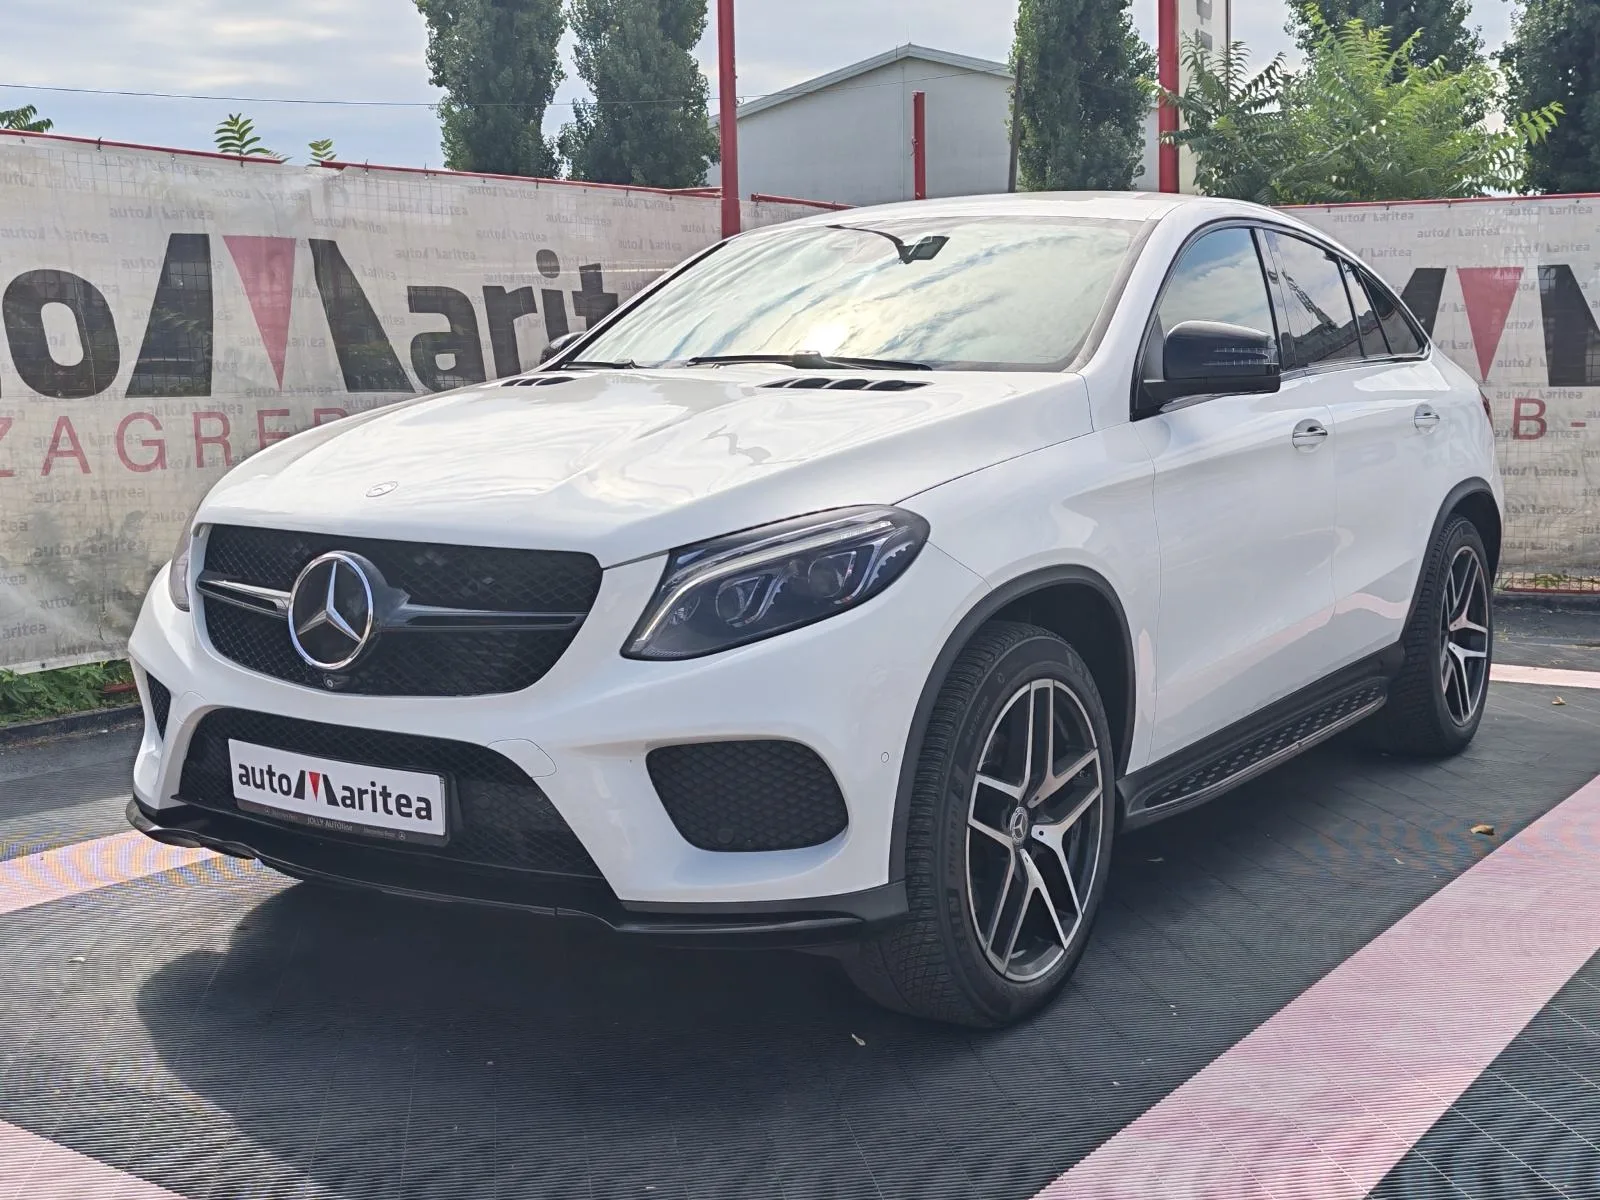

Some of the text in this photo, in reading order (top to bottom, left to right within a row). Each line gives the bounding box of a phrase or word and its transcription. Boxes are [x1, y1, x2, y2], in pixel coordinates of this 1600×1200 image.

[1332, 211, 1415, 222] autoMaritea
[1417, 226, 1501, 239] autoMaritea
[238, 763, 432, 821] autoMaritea
